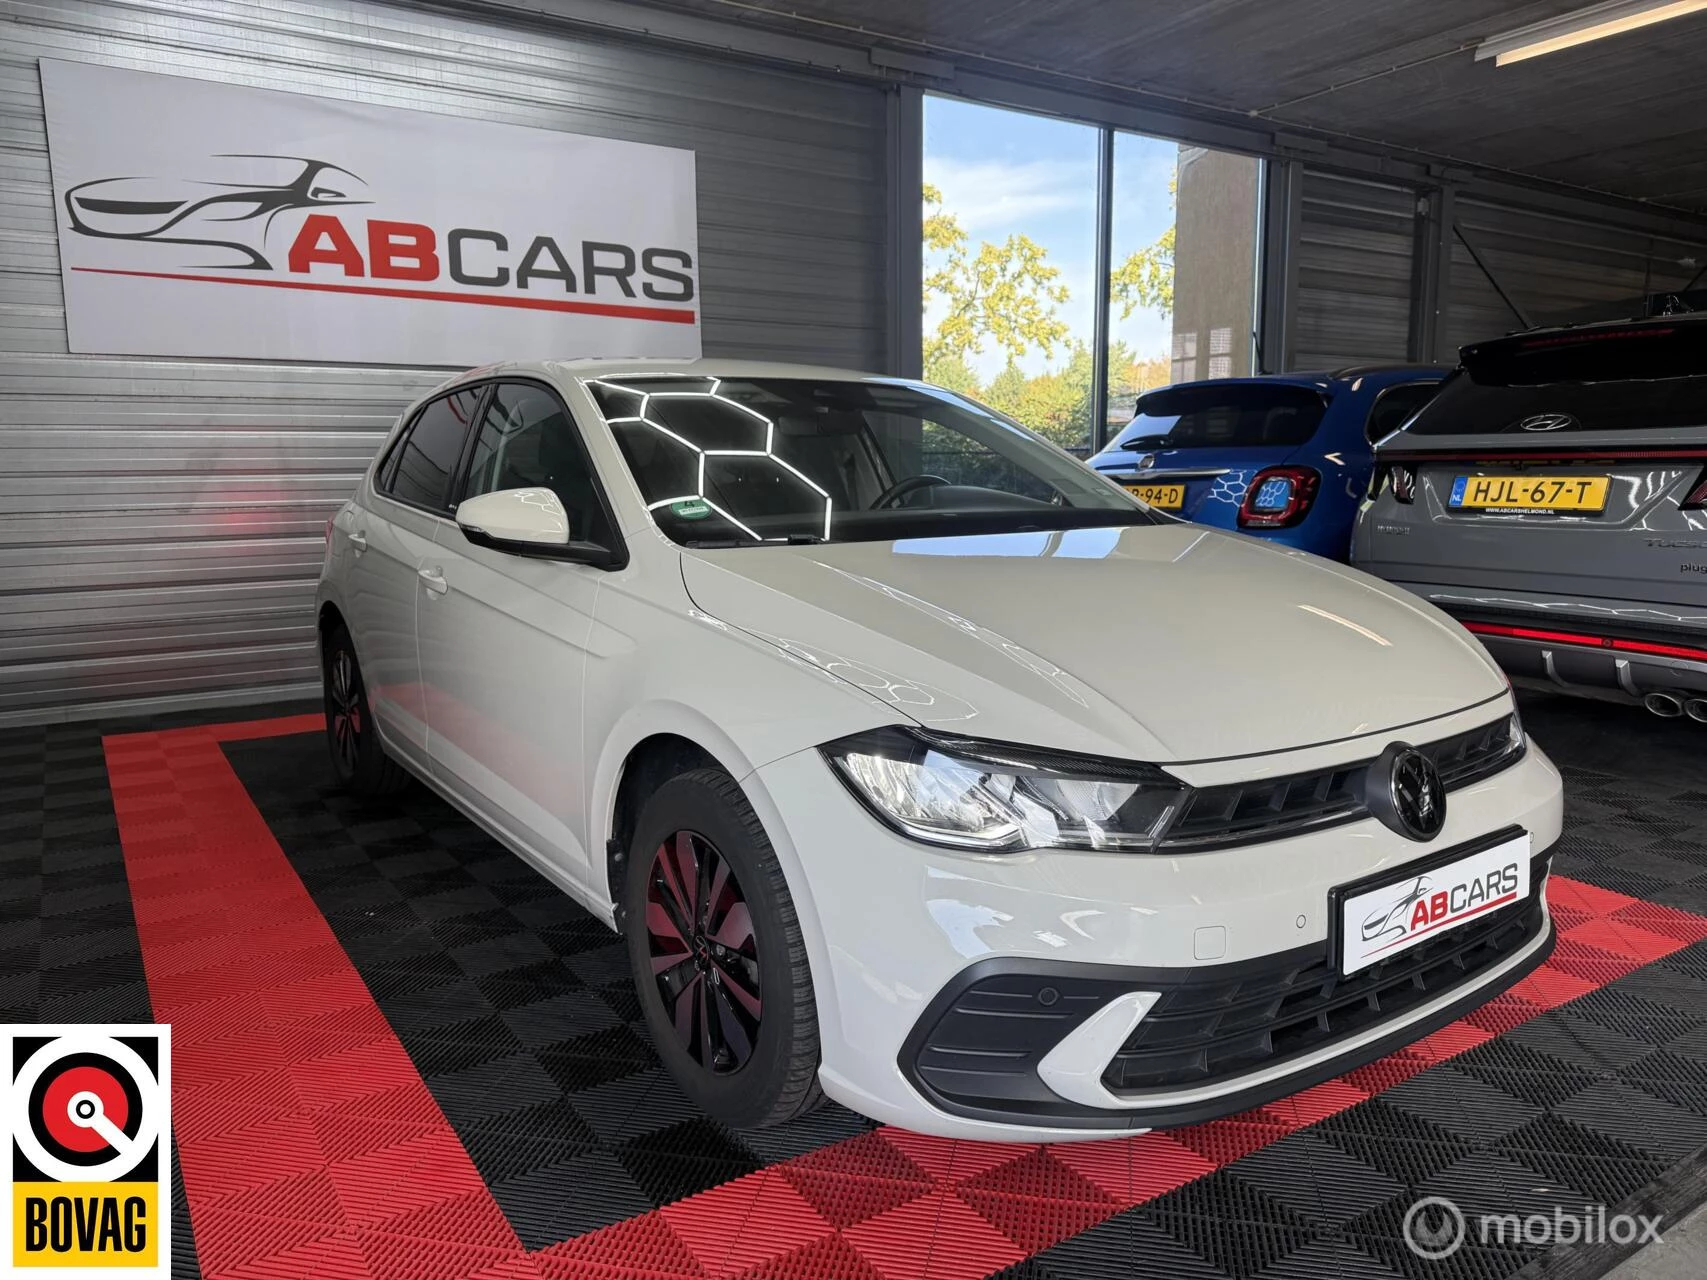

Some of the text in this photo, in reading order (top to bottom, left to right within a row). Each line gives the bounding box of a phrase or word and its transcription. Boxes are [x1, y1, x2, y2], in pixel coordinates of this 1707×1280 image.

[288, 213, 694, 302] ABCARS
[1452, 494, 1462, 502] NL
[1473, 481, 1592, 504] HJL-67-T
[1410, 862, 1518, 931] ABCARS
